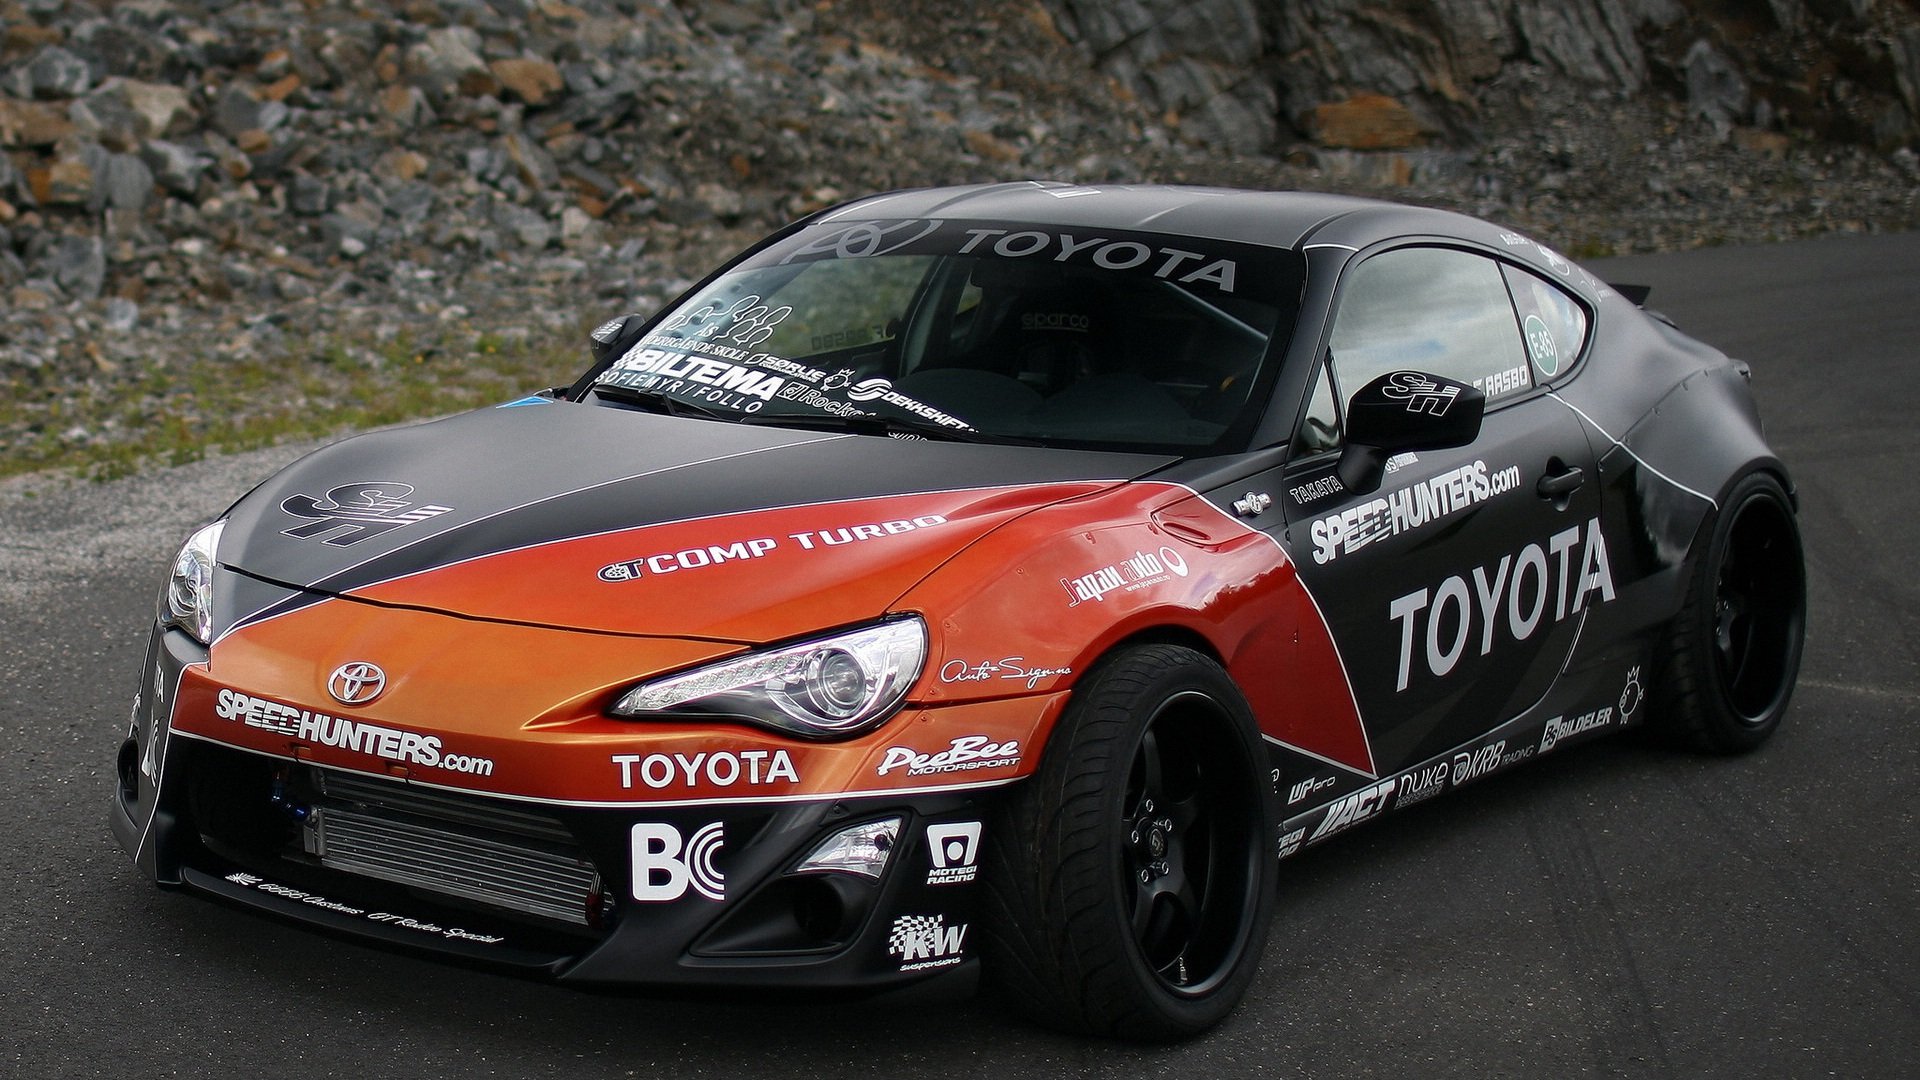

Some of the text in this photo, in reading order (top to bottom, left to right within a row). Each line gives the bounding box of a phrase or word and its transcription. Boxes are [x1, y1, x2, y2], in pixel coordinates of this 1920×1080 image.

[957, 229, 1237, 292] TOYOTA
[1021, 312, 1089, 332] sparco
[709, 345, 750, 360] SKOLE
[1530, 331, 1554, 359] E-85
[623, 349, 785, 402] BILTEMA
[693, 387, 763, 414] FOLLO
[1289, 475, 1344, 505] TAKATA
[1310, 460, 1521, 565] SPEEDHUNTERS.com
[647, 538, 778, 575] COMP
[788, 515, 949, 550] TURBO
[1389, 517, 1616, 692] TOYOTA
[216, 688, 493, 777] SPEEDHUNTERS.com
[1557, 706, 1613, 740] BILDELER
[612, 749, 800, 788] TOYOTA
[907, 758, 1020, 776] MOTORSPORT
[631, 821, 725, 901] BC
[928, 865, 977, 877] MOTEGI
[926, 873, 976, 885] RACING
[303, 896, 364, 914] Customs
[368, 913, 404, 921] GT
